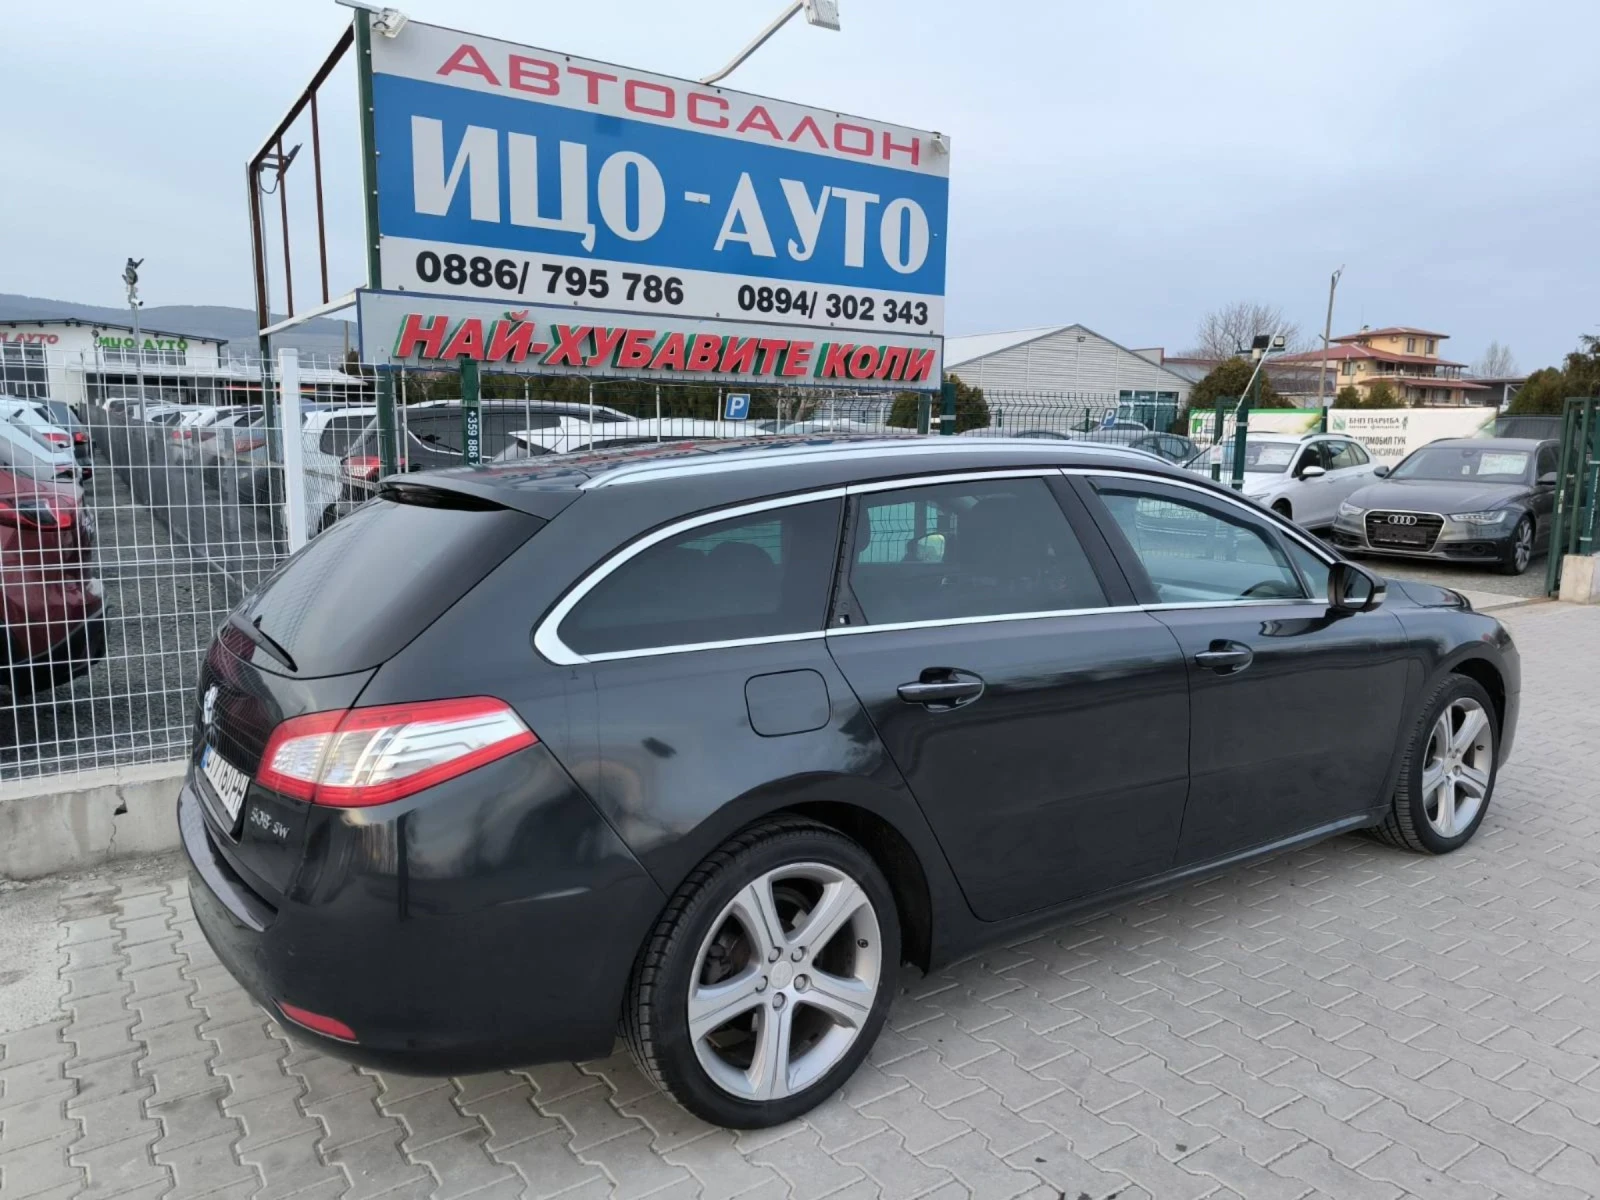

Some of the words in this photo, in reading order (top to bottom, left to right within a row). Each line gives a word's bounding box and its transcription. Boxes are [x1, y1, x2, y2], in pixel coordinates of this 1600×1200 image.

[436, 44, 919, 165] АВТОСАЛОН
[416, 251, 530, 294] 0886/
[542, 263, 609, 298] 795
[622, 272, 684, 305] 786
[738, 284, 818, 319] 0894/
[826, 293, 874, 321] 302
[883, 299, 928, 325] 343
[815, 343, 936, 381] КОЛИ
[730, 397, 744, 415] P
[1103, 410, 1114, 424] P
[467, 410, 478, 436] +359
[467, 439, 478, 458] 886
[272, 821, 290, 839] SW
